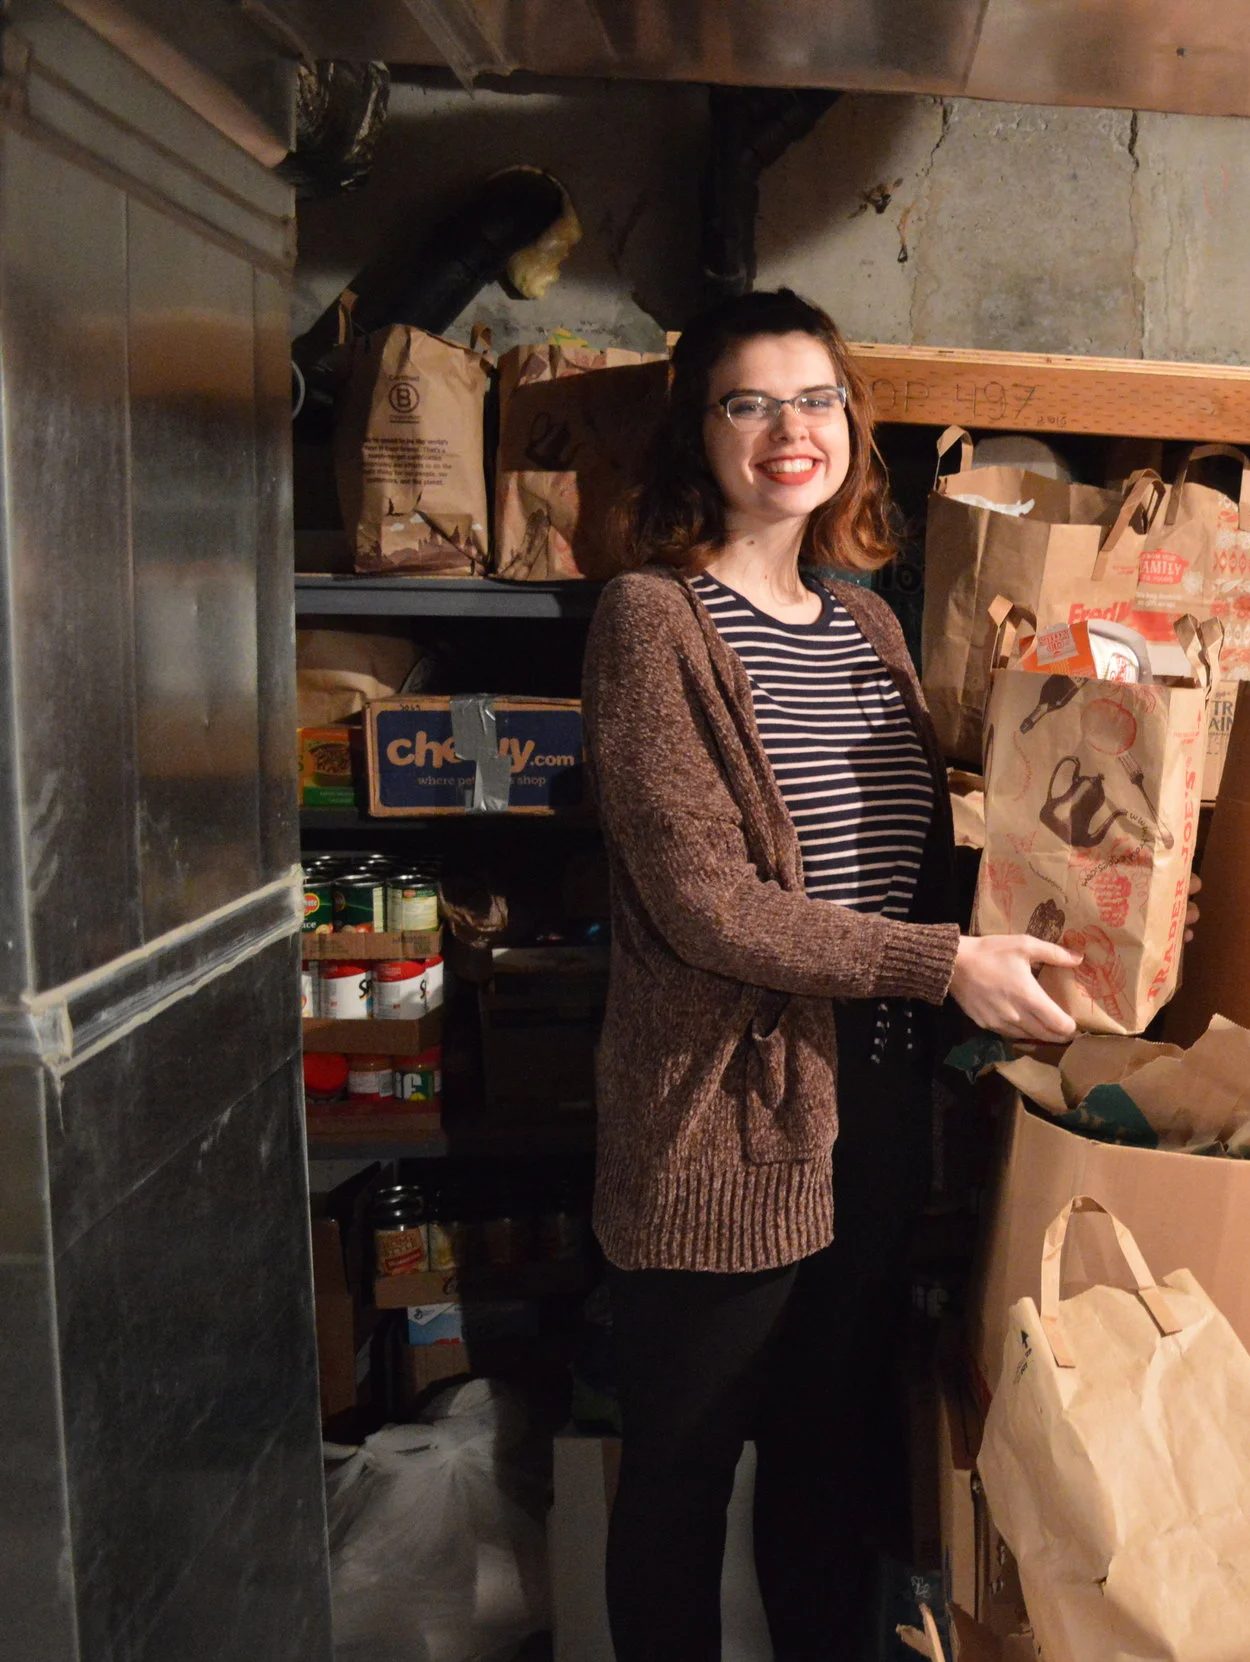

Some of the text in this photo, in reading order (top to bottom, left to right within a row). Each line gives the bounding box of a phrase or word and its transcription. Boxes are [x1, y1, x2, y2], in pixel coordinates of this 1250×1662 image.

[1142, 559, 1182, 577] AMILY
[386, 730, 575, 773] chey.com
[417, 774, 455, 786] where
[517, 775, 547, 788] shop
[1147, 878, 1184, 1002] TRADER
[1181, 770, 1196, 865] JOE'S
